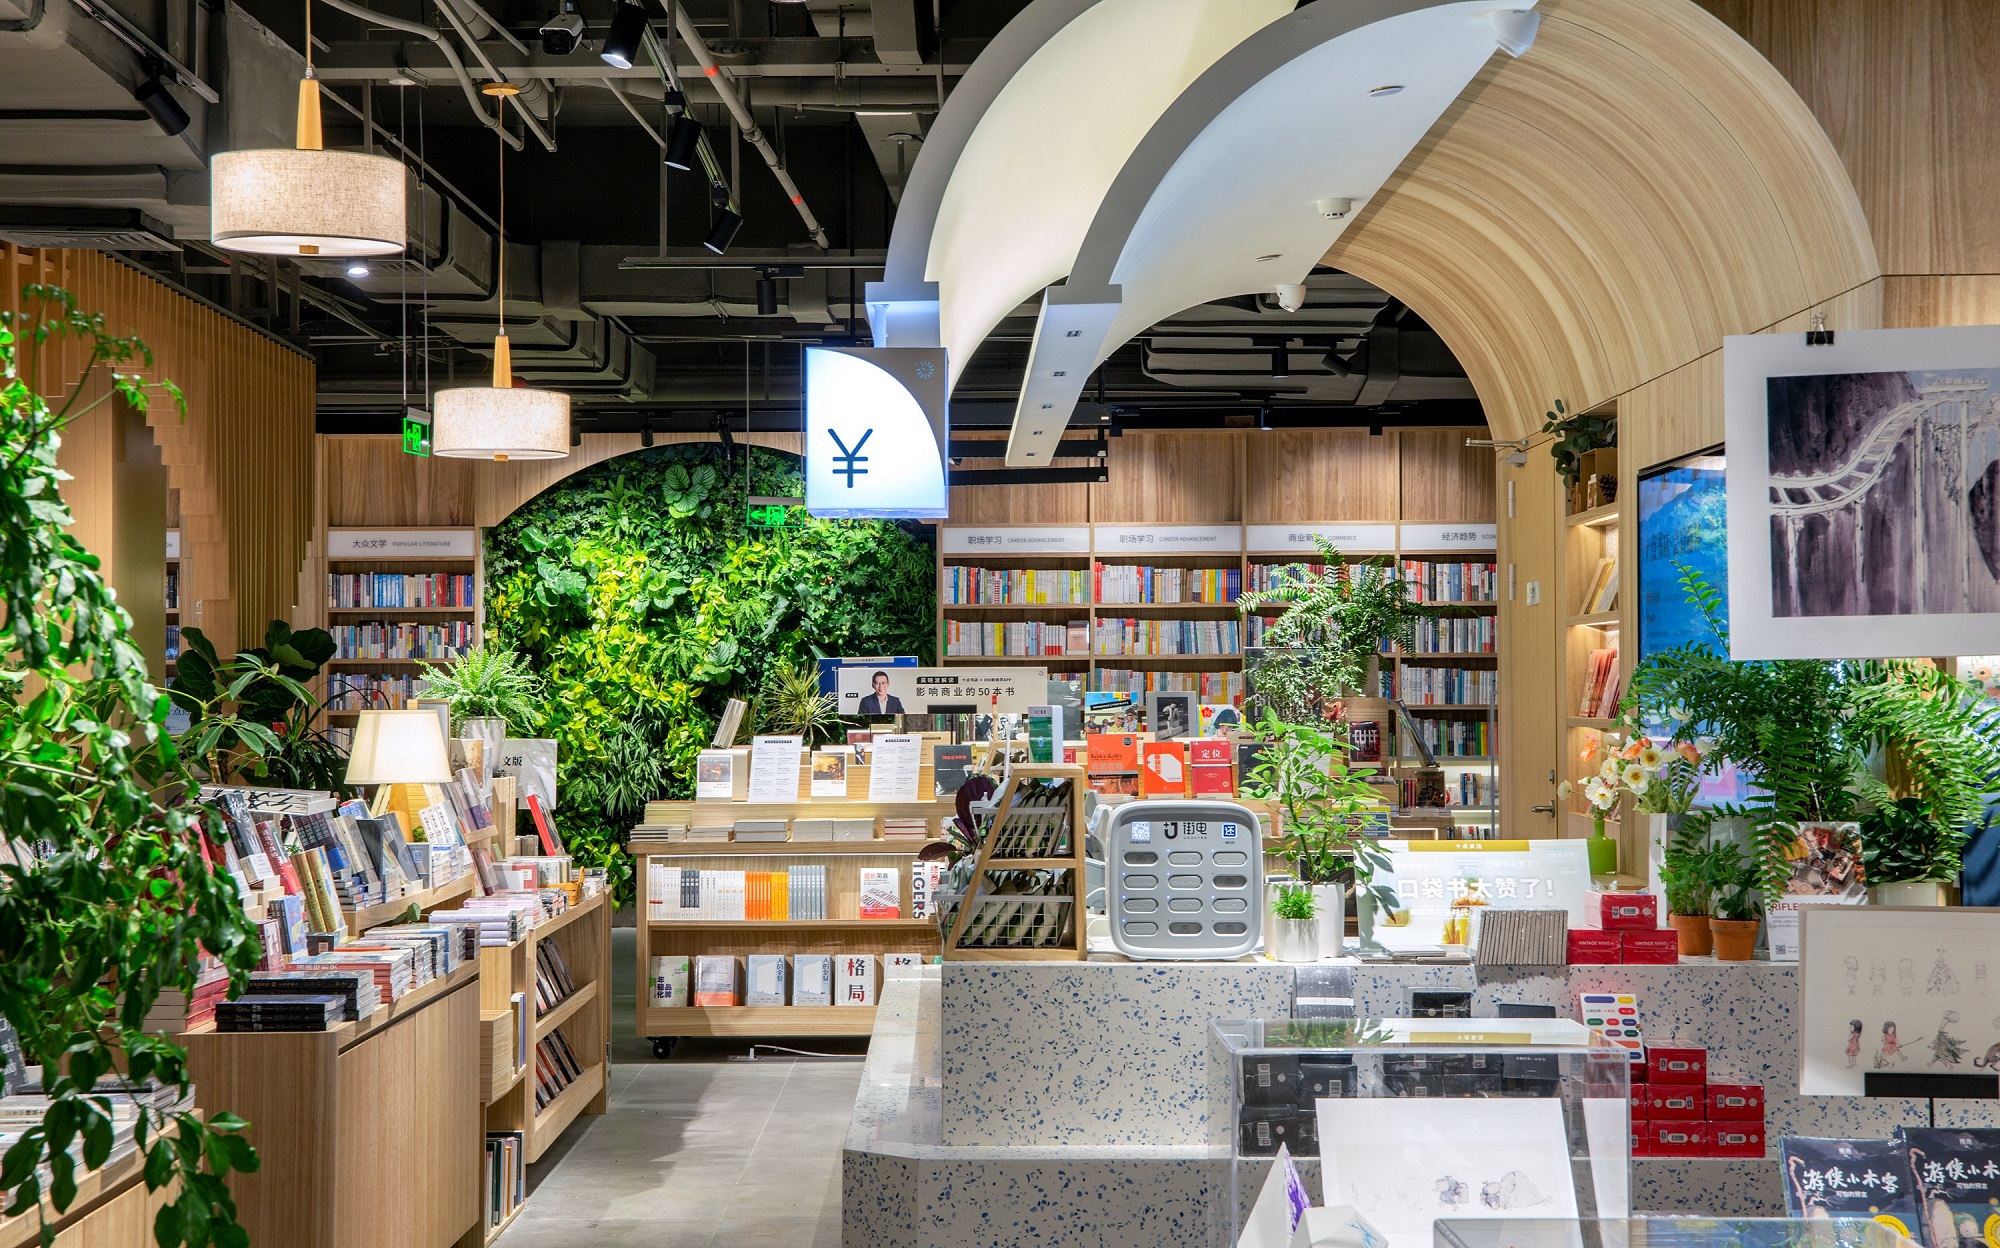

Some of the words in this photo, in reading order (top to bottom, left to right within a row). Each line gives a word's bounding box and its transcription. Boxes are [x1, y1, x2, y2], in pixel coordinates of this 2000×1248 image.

[967, 535, 1002, 545] 职场学习
[1119, 534, 1154, 544] 职场学习
[1441, 532, 1477, 541] 经济趋势
[352, 539, 387, 548] 大众文学
[916, 687, 1015, 697] 影响商业的50本书
[1201, 749, 1221, 758] 定位
[502, 756, 522, 766] 文版
[1183, 822, 1207, 835] 街电
[1224, 826, 1235, 836] 还
[1397, 877, 1555, 900] 口袋书太赞了！
[1771, 903, 1799, 911] RIFLE
[848, 958, 866, 1002] 格局
[1922, 1157, 2000, 1184] 游侠小木
[1802, 1166, 1899, 1194] 游侠小木客
